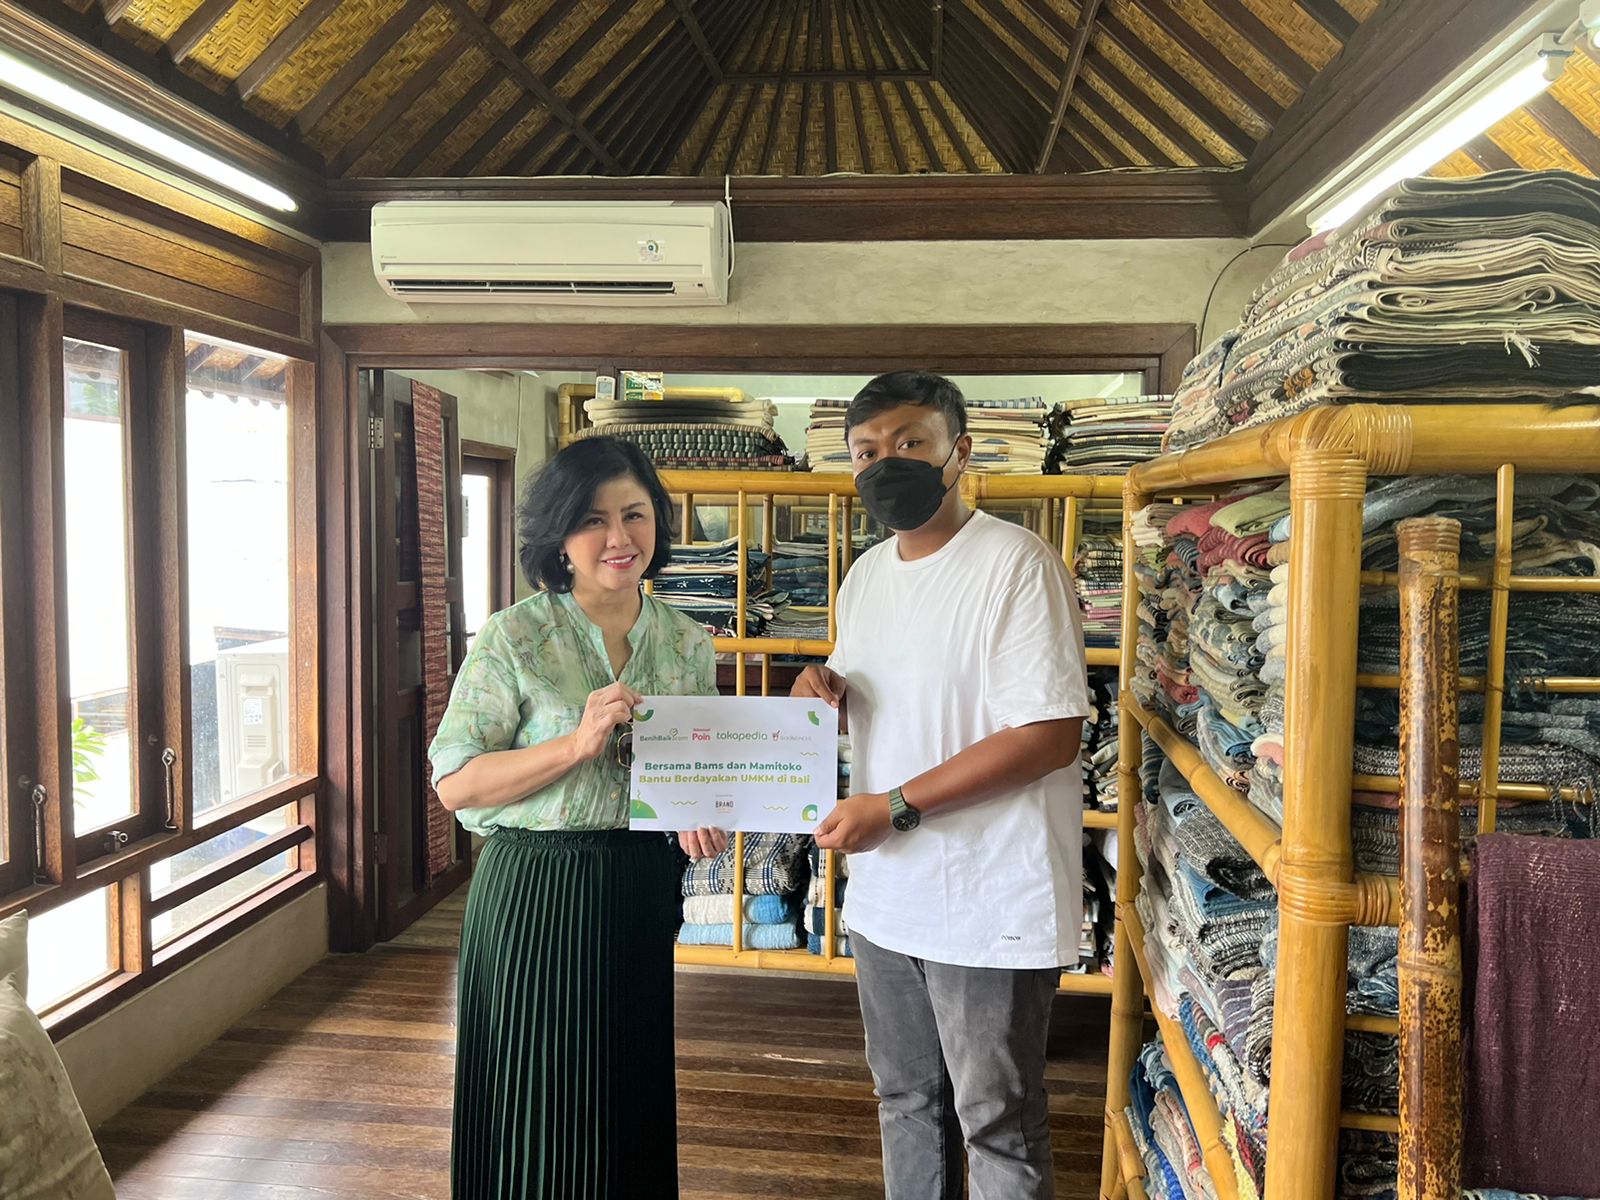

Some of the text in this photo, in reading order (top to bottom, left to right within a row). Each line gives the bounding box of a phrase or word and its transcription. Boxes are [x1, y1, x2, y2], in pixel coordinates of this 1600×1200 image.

[692, 733, 711, 741] Poin
[716, 731, 768, 742] tokopedia
[644, 761, 802, 771] Bersama Bams dan Mamitoko
[639, 774, 811, 785] Bantu Berdayakan UMKM di Bali
